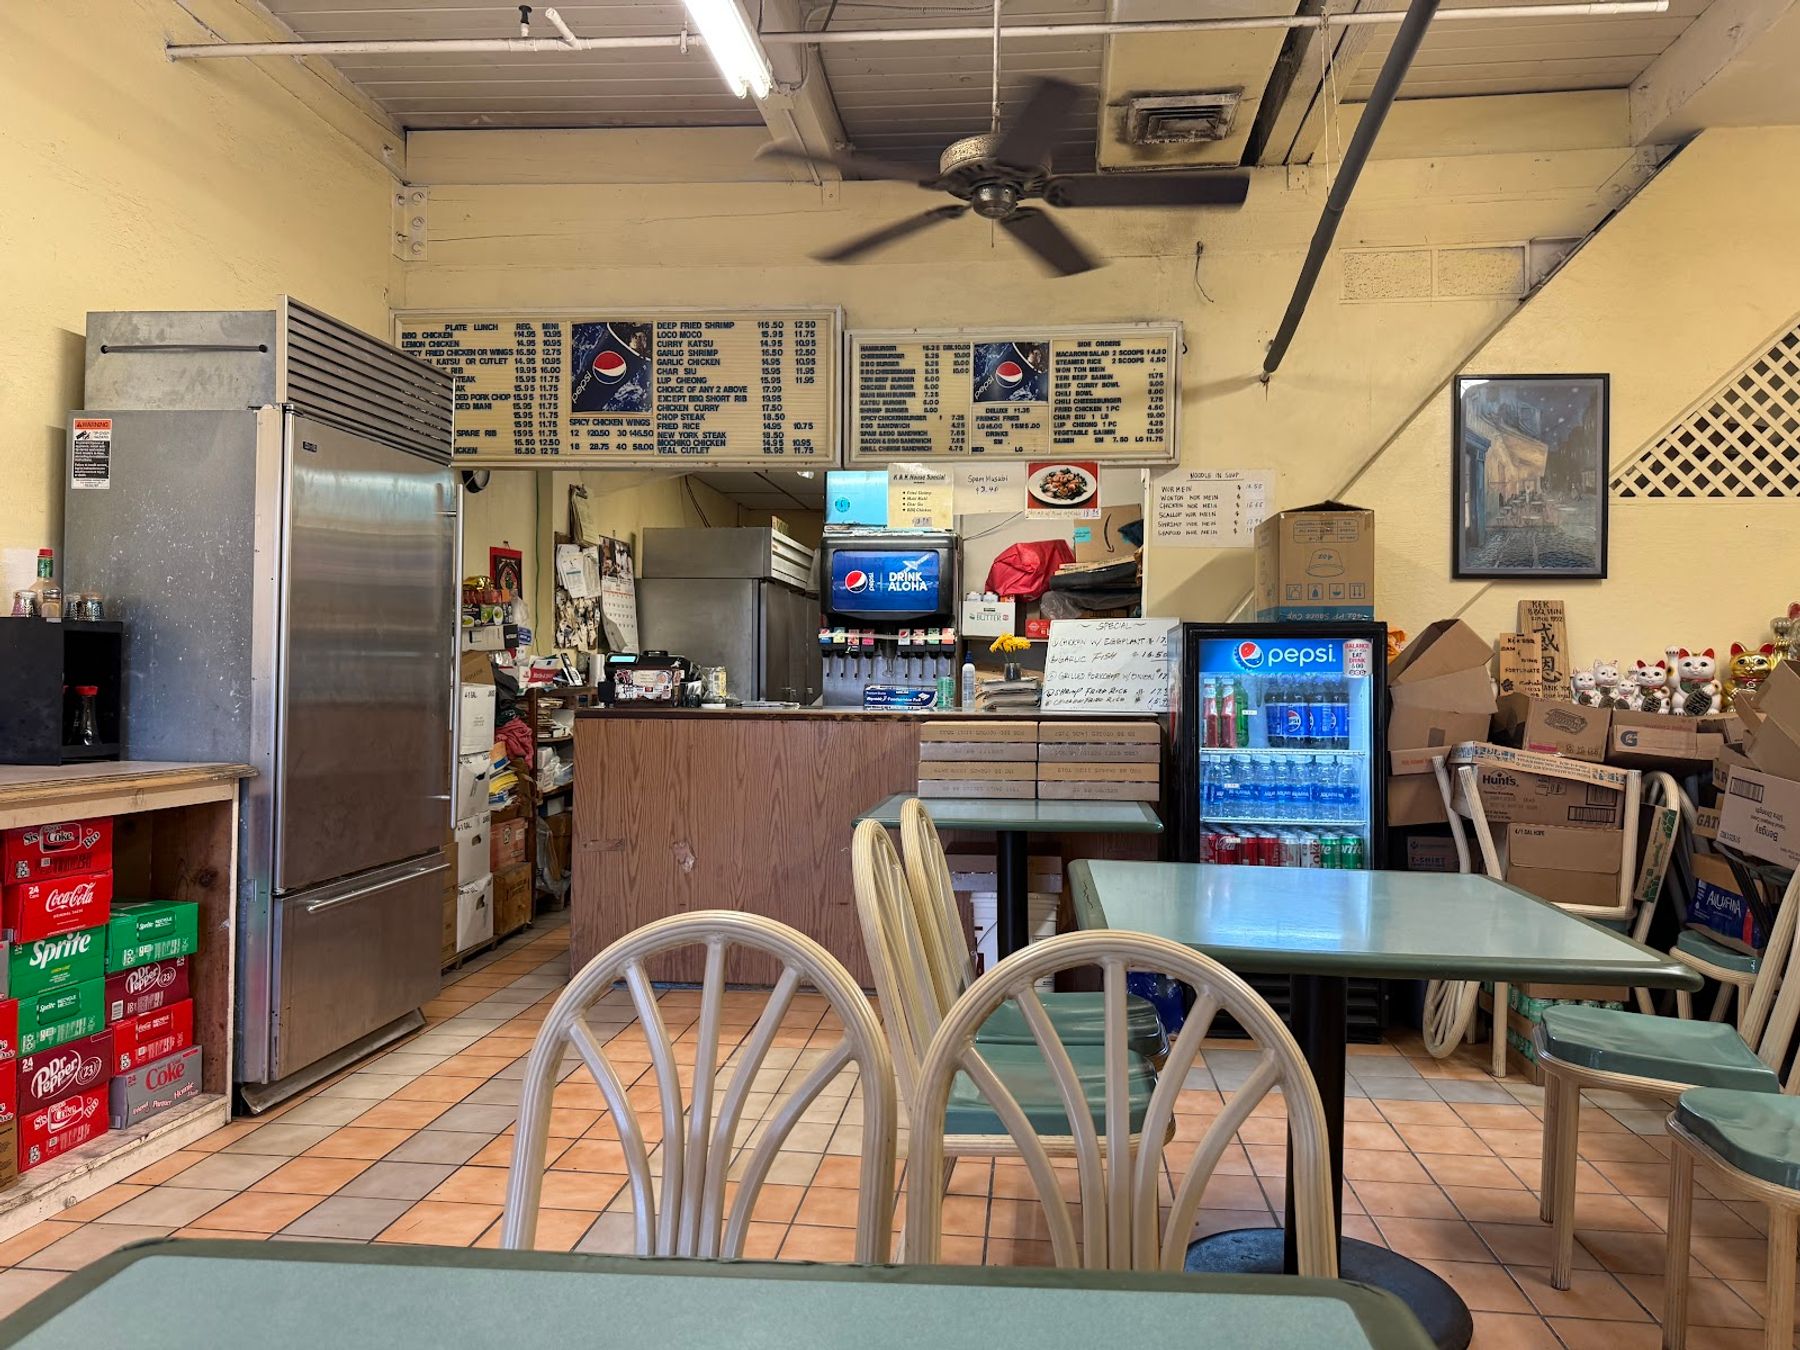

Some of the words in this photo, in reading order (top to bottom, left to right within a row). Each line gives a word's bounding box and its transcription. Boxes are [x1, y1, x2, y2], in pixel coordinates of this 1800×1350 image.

[572, 371, 592, 403] pepsi
[975, 375, 994, 399] pepsi
[968, 475, 984, 484] Spam
[868, 572, 876, 592] pepsi
[888, 572, 922, 582] DRINK
[888, 582, 928, 592] ALOHA
[976, 613, 1002, 622] BUTTER
[1096, 622, 1132, 630] SPECIAL
[1092, 650, 1118, 662] FISH
[1268, 644, 1336, 667] pepsi
[24, 832, 40, 846] Sis
[48, 831, 74, 843] Coke
[83, 832, 100, 848] Bro
[28, 886, 40, 895] 24
[1706, 890, 1742, 917] AQUAFINA
[30, 932, 92, 970] Sprite
[138, 966, 150, 978] Dr
[128, 967, 158, 994] Pepper
[22, 1056, 33, 1070] 24
[49, 1056, 67, 1077] Dr
[36, 1058, 78, 1099] Pepper
[84, 1065, 94, 1078] 23
[146, 1062, 185, 1090] Coke
